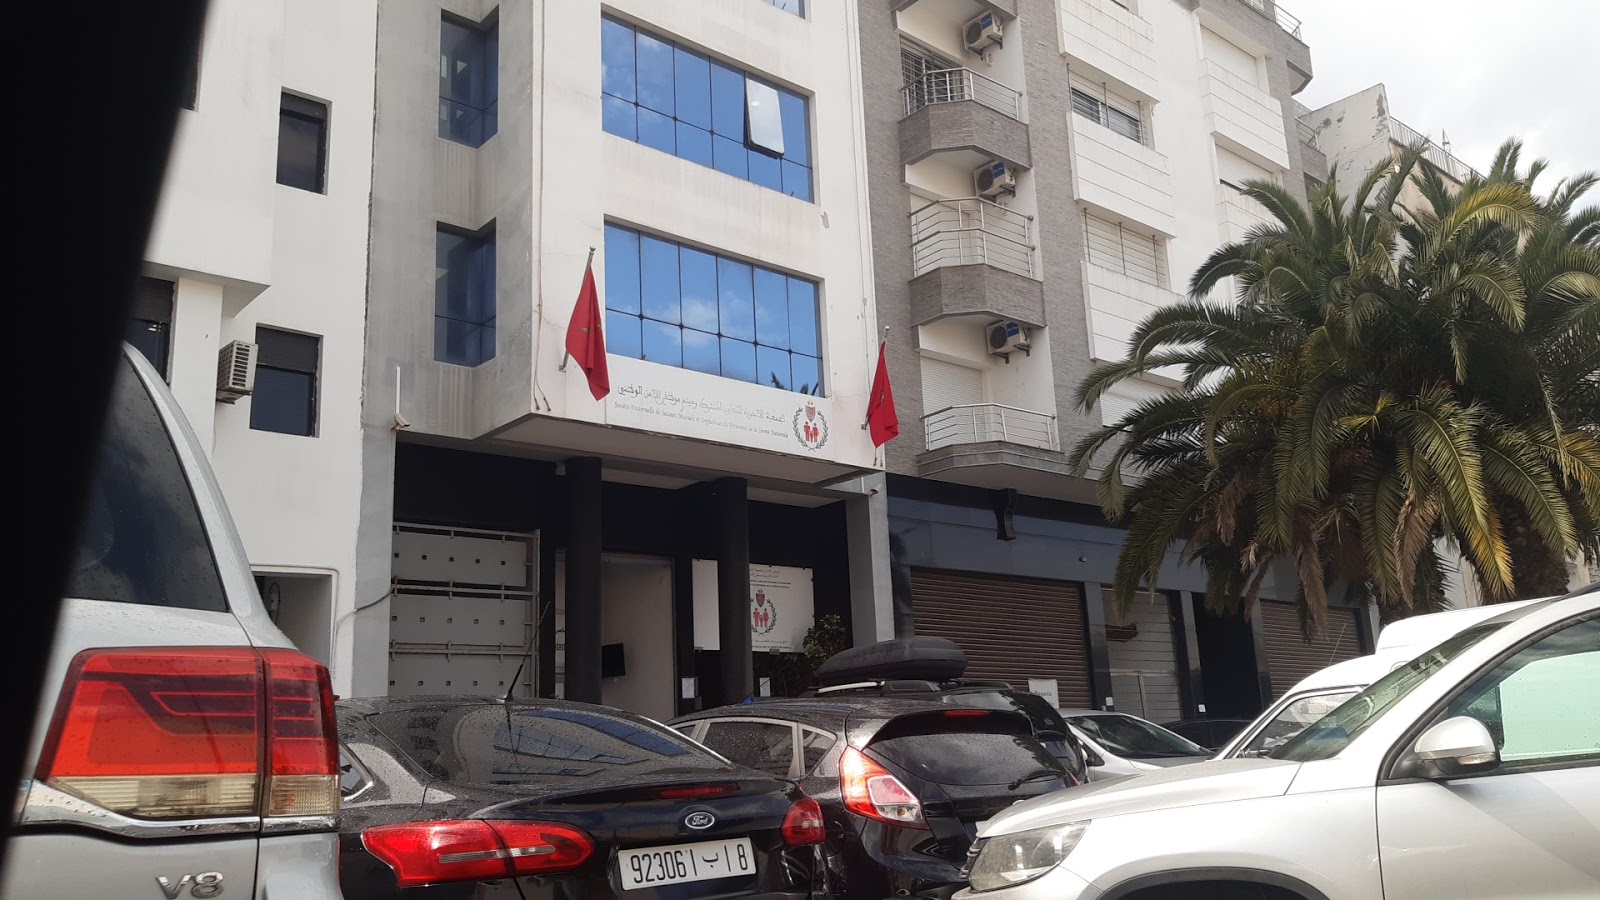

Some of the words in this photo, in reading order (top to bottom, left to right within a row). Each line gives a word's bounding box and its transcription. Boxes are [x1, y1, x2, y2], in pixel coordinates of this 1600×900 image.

[617, 384, 643, 398] الوطني
[691, 815, 709, 826] Ford
[630, 850, 687, 883] 92306
[736, 843, 748, 871] 8
[155, 871, 224, 899] V8
